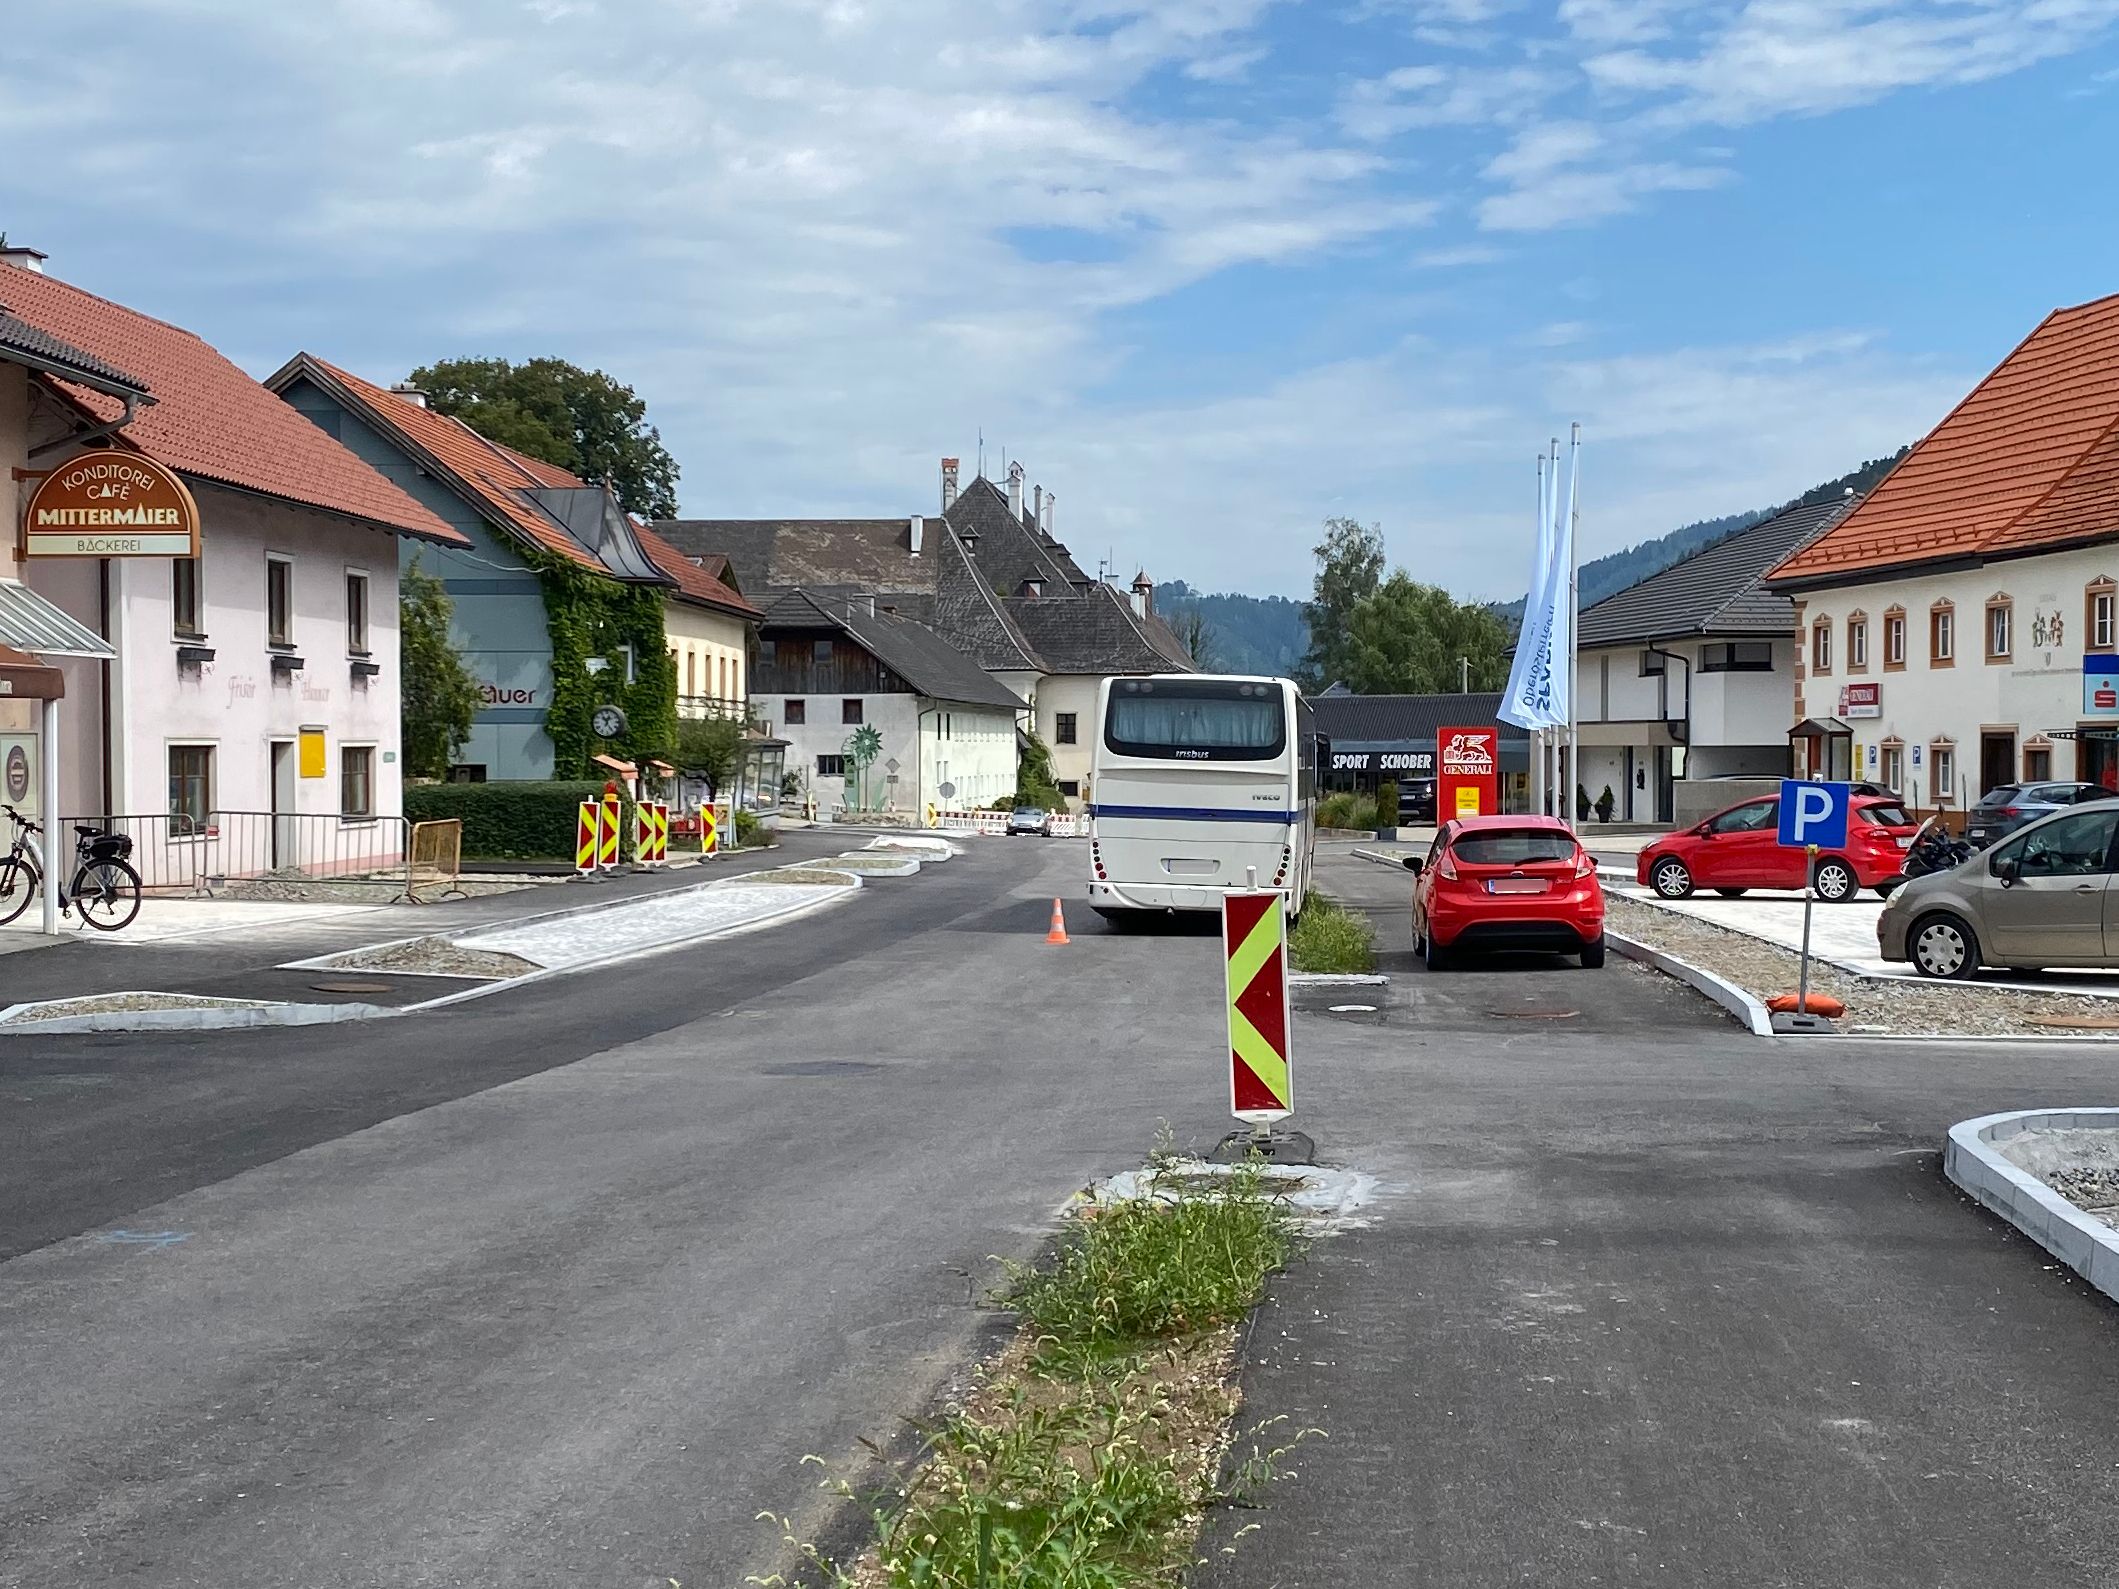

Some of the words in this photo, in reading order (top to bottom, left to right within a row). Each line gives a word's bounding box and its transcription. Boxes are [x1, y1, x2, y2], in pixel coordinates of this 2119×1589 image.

[61, 464, 156, 492] KONDITOREI
[37, 502, 180, 526] MITTERMAIER
[1332, 754, 1370, 769] SPORT
[1380, 754, 1432, 769] SCHOBER
[1443, 764, 1493, 775] GENERALI
[1794, 786, 1834, 842] P
